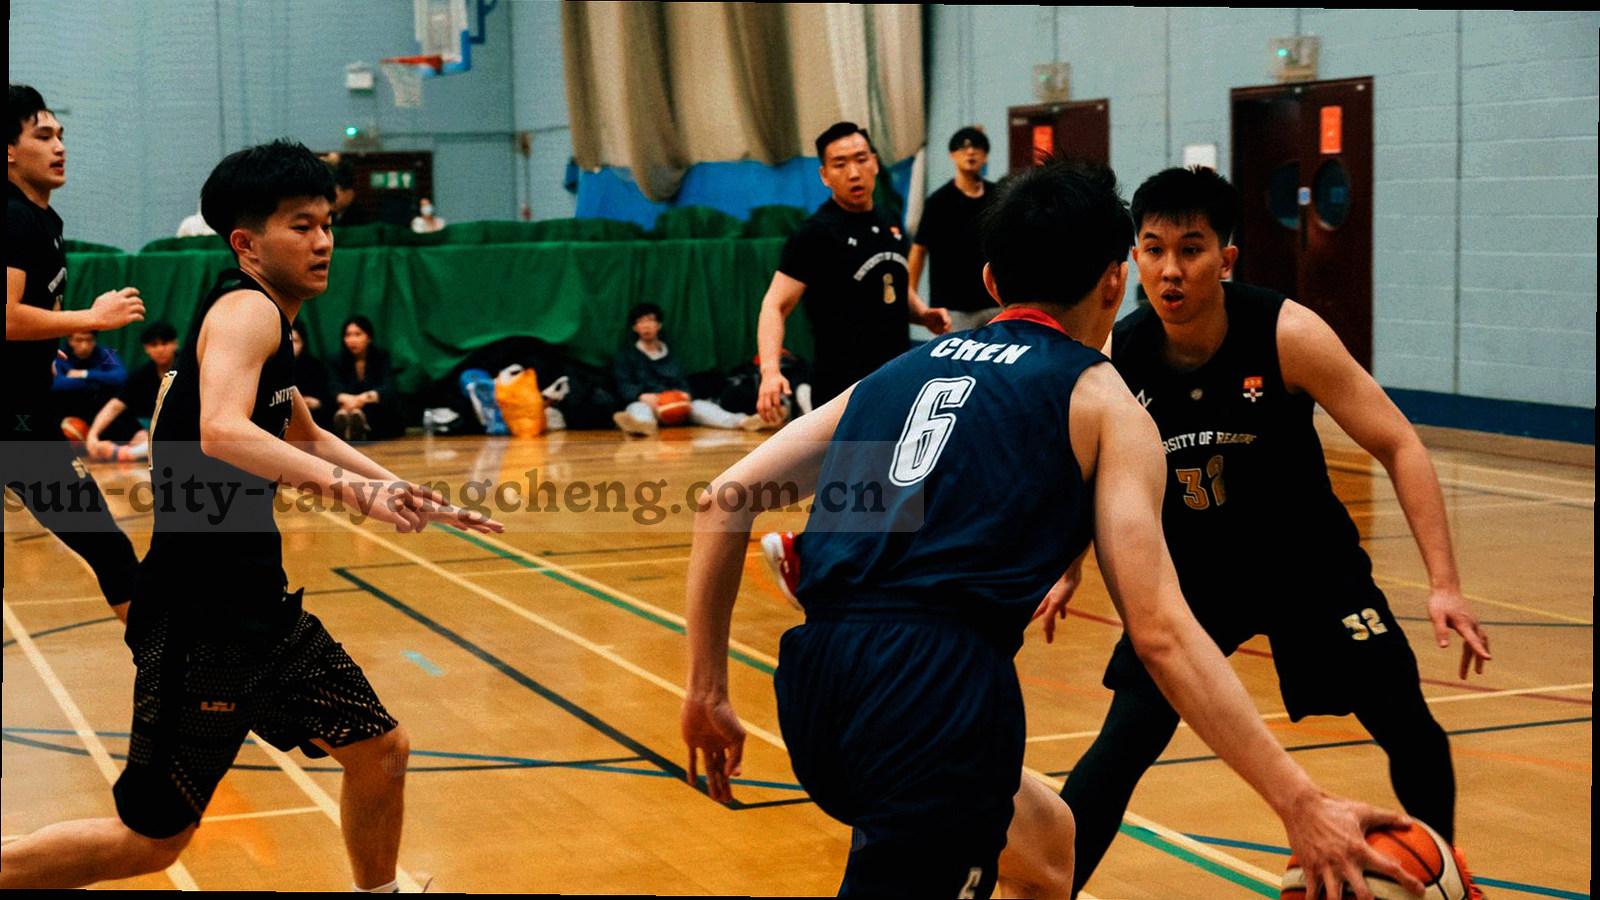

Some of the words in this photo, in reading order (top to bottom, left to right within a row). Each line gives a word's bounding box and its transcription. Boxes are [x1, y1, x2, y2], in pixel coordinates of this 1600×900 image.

[930, 337, 1031, 364] CHEN
[888, 375, 977, 487] 6
[1162, 432, 1197, 455] RSITY
[1198, 430, 1214, 446] OF
[1341, 607, 1389, 641] 32
